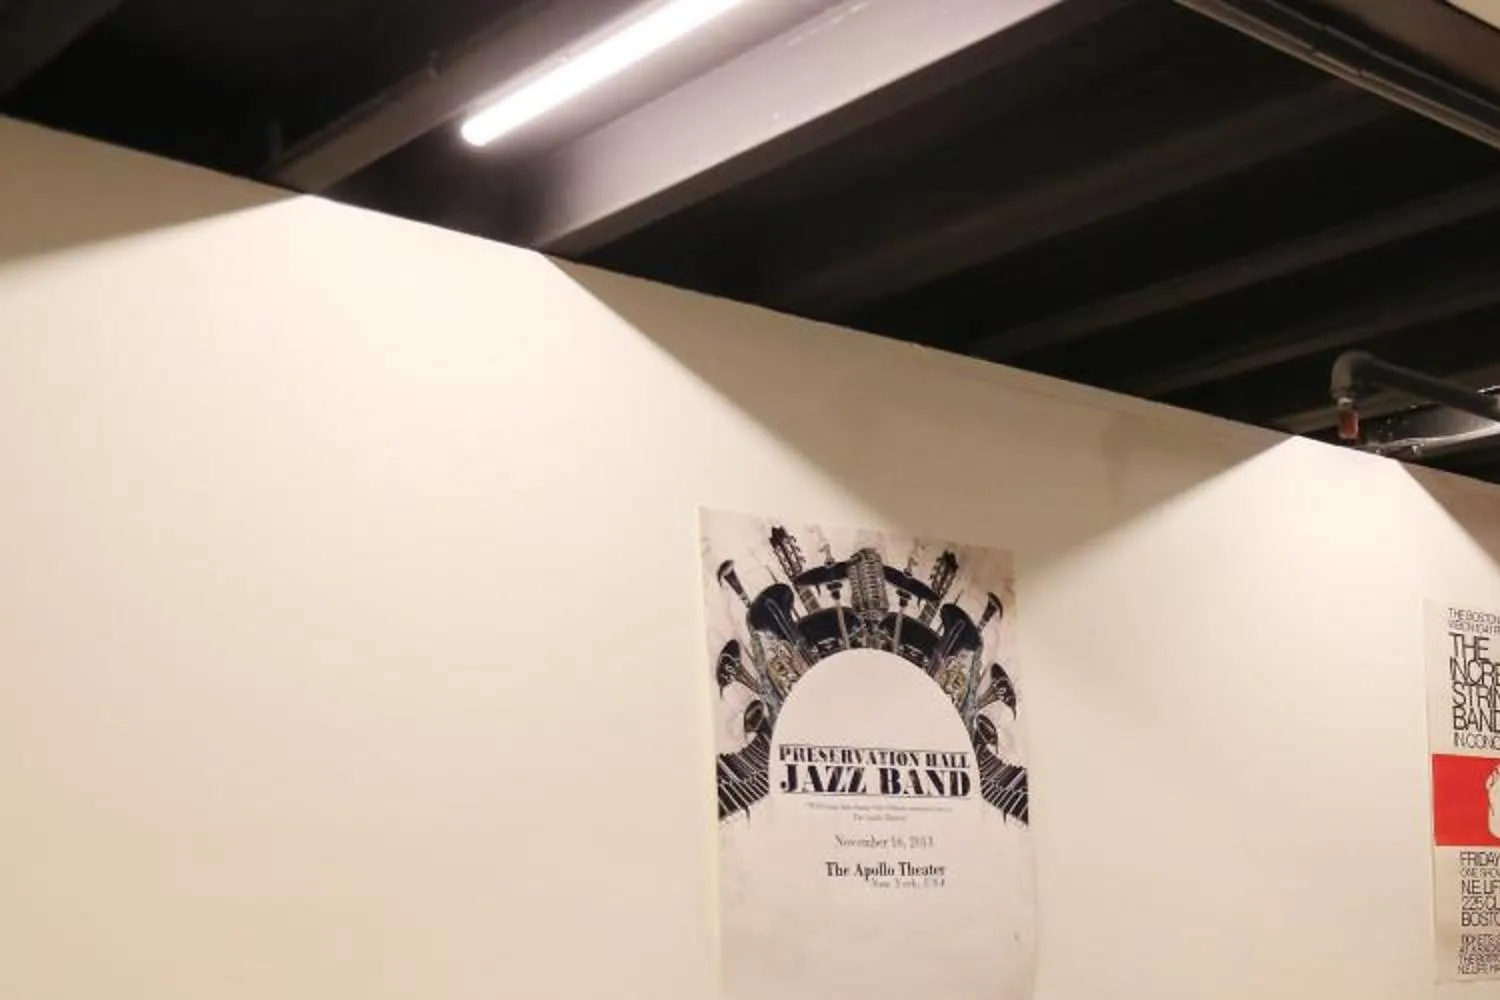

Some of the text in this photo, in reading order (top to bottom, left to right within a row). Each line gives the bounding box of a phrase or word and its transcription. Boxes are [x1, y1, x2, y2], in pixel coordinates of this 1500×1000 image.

[1448, 632, 1490, 661] THE
[1454, 731, 1465, 748] IN
[780, 746, 971, 768] PRESERVATION HALL
[780, 763, 971, 797] JAZZ BAND
[834, 834, 888, 849] November
[825, 861, 946, 881] The Apollo Theater
